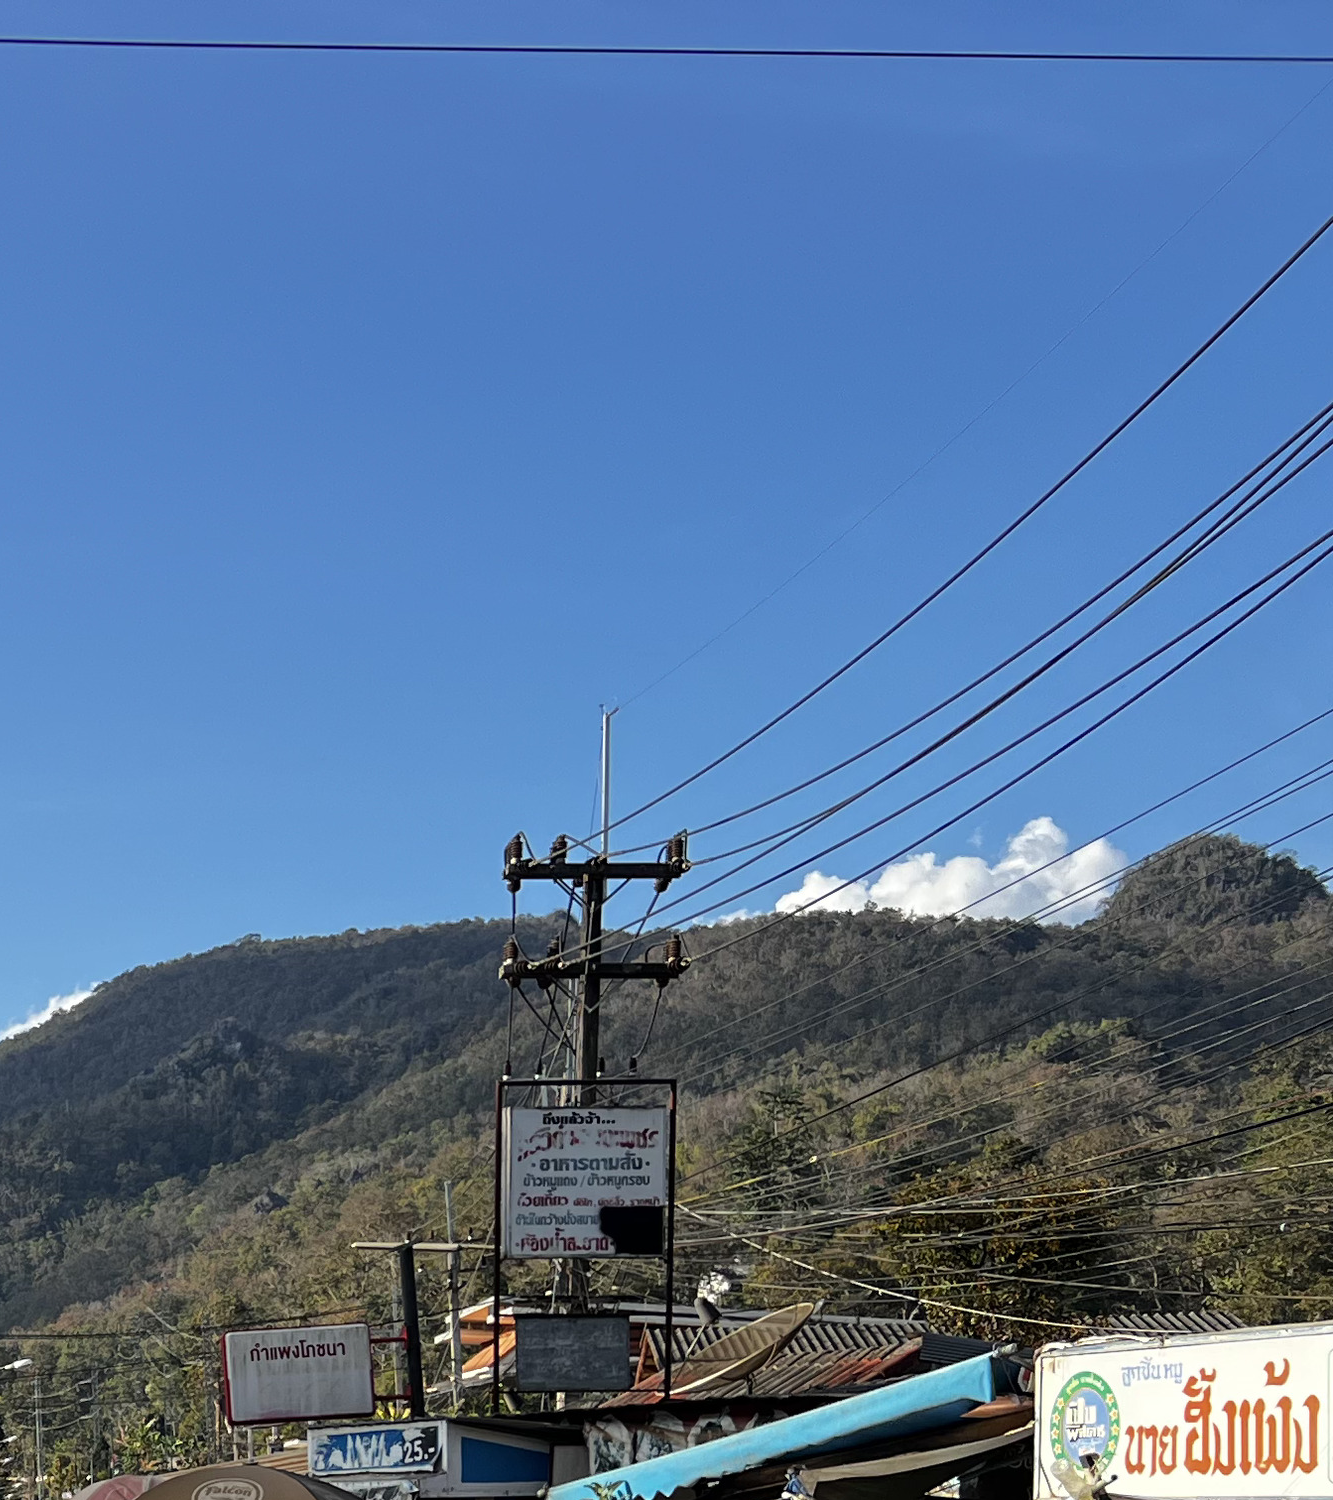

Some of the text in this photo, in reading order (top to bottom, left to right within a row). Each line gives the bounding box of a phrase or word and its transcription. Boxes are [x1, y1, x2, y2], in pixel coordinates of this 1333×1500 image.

[1121, 1356, 1162, 1387] ลูกชิ้น
[1163, 1361, 1184, 1384] หมู
[403, 1440, 435, 1464] 25.-
